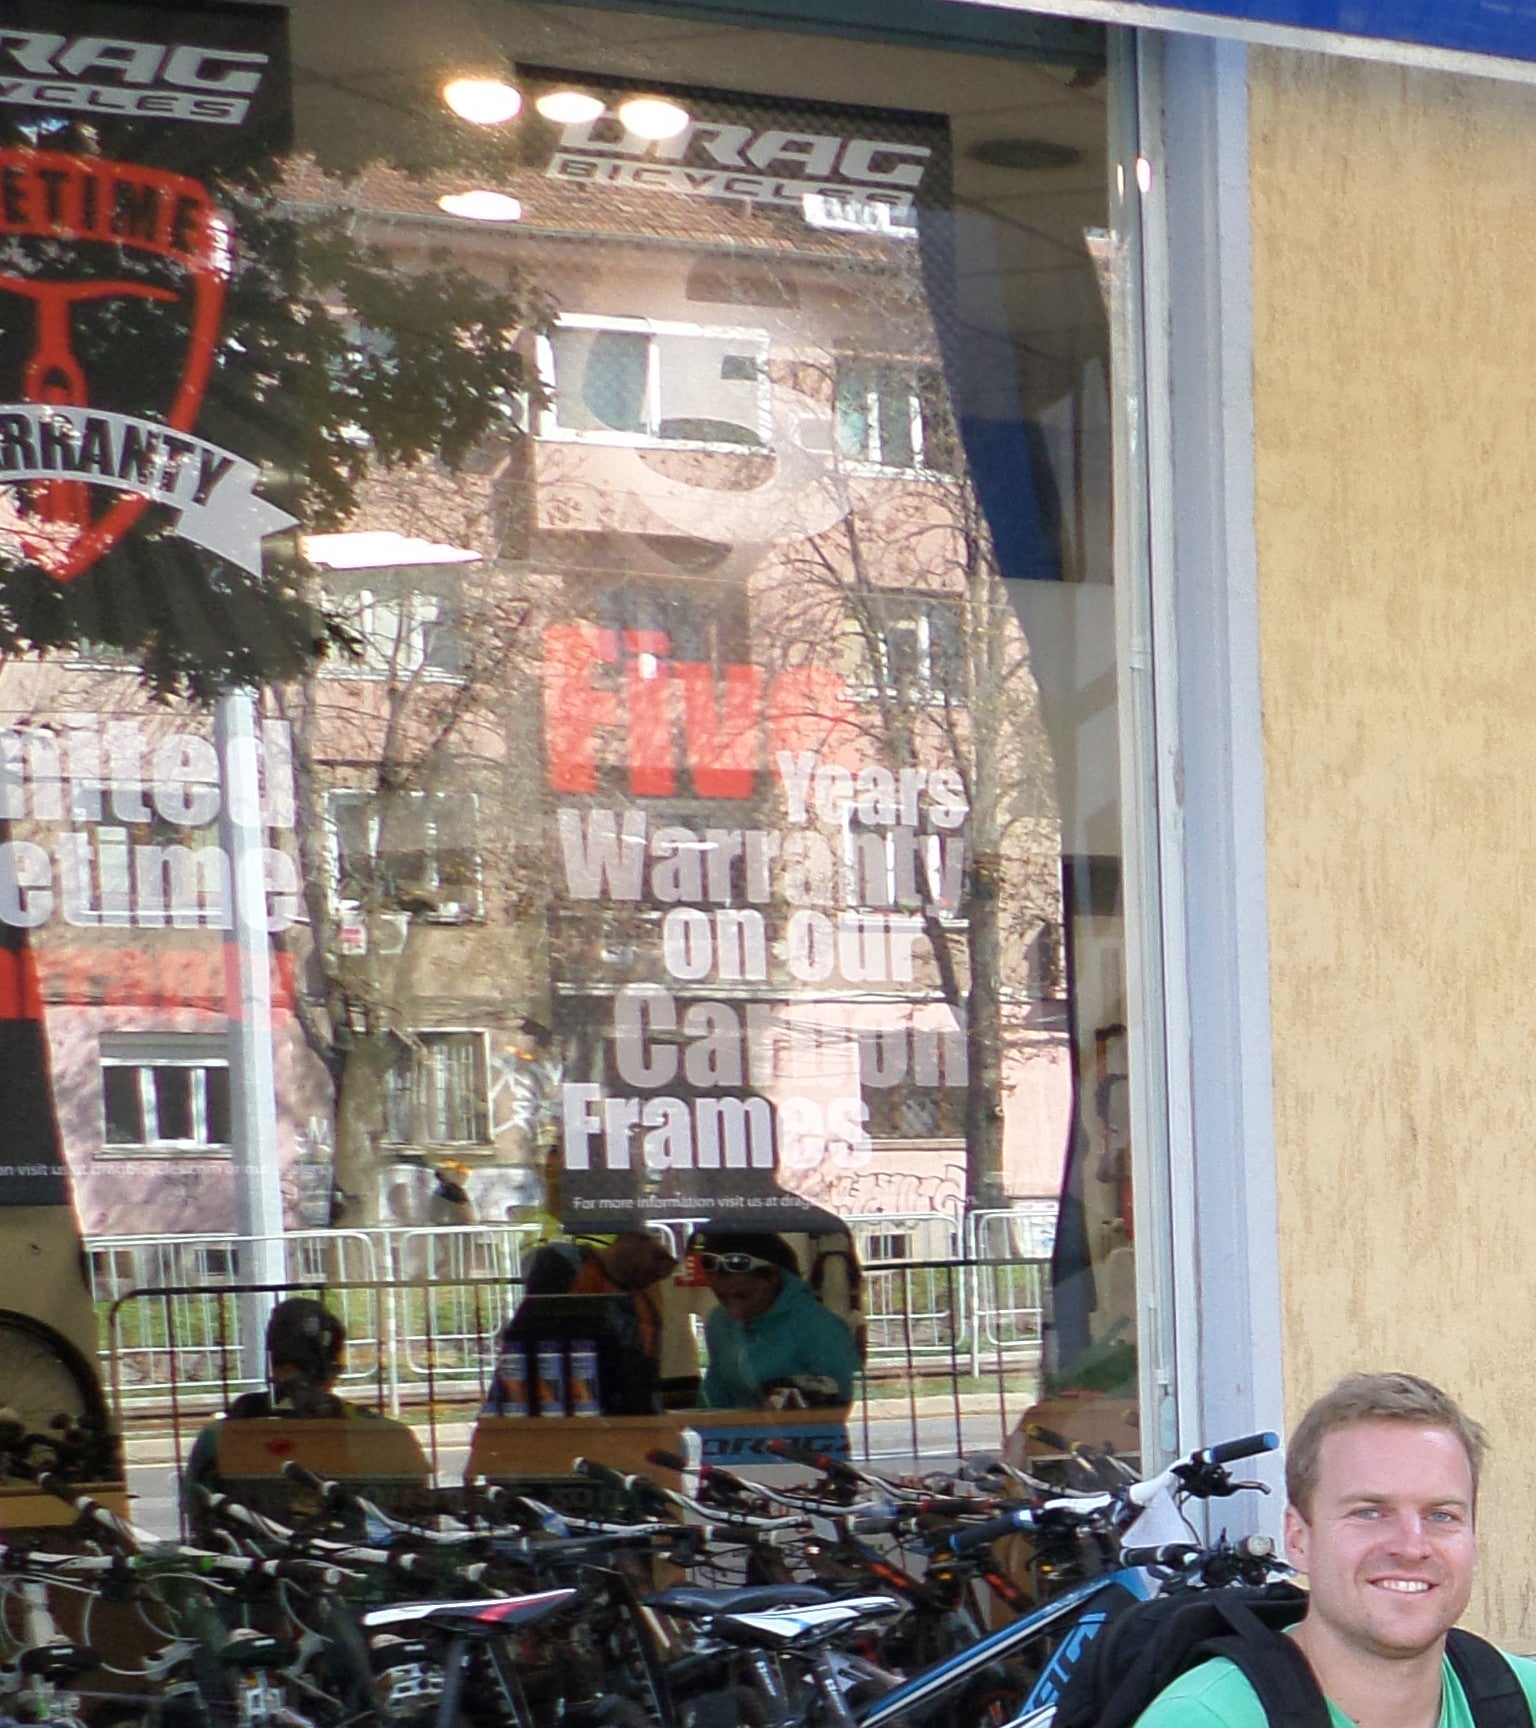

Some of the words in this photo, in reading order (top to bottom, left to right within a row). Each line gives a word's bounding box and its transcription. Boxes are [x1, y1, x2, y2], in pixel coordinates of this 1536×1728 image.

[776, 751, 970, 828] Years
[557, 808, 965, 919] Warranty
[664, 907, 767, 981] on
[788, 908, 928, 983] our
[613, 984, 969, 1089] Caron
[562, 1083, 873, 1170] Frames
